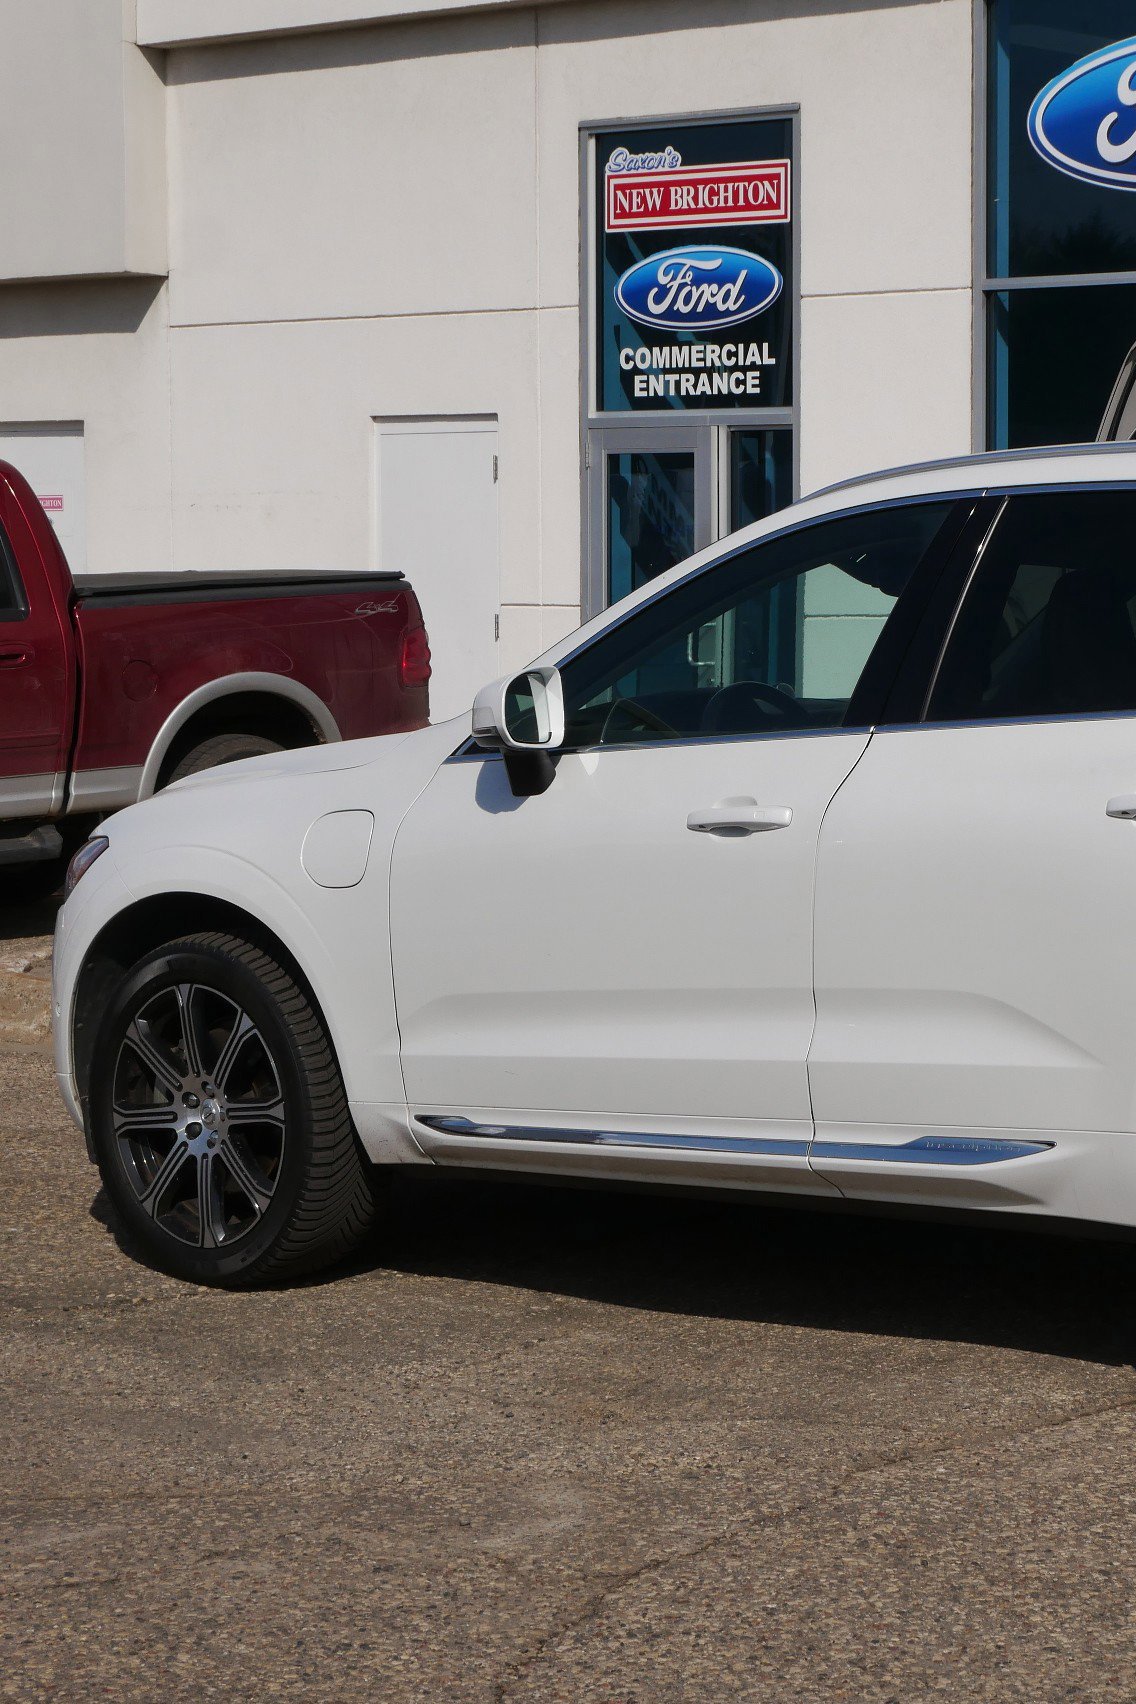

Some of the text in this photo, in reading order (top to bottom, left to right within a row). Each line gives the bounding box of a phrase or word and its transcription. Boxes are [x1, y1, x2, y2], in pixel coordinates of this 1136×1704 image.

[606, 148, 680, 172] Saxon's
[615, 179, 779, 214] NEW BRIGHTON
[647, 257, 748, 315] Ford
[619, 342, 776, 371] COMMERCIAL
[633, 371, 761, 398] ENTRANCE
